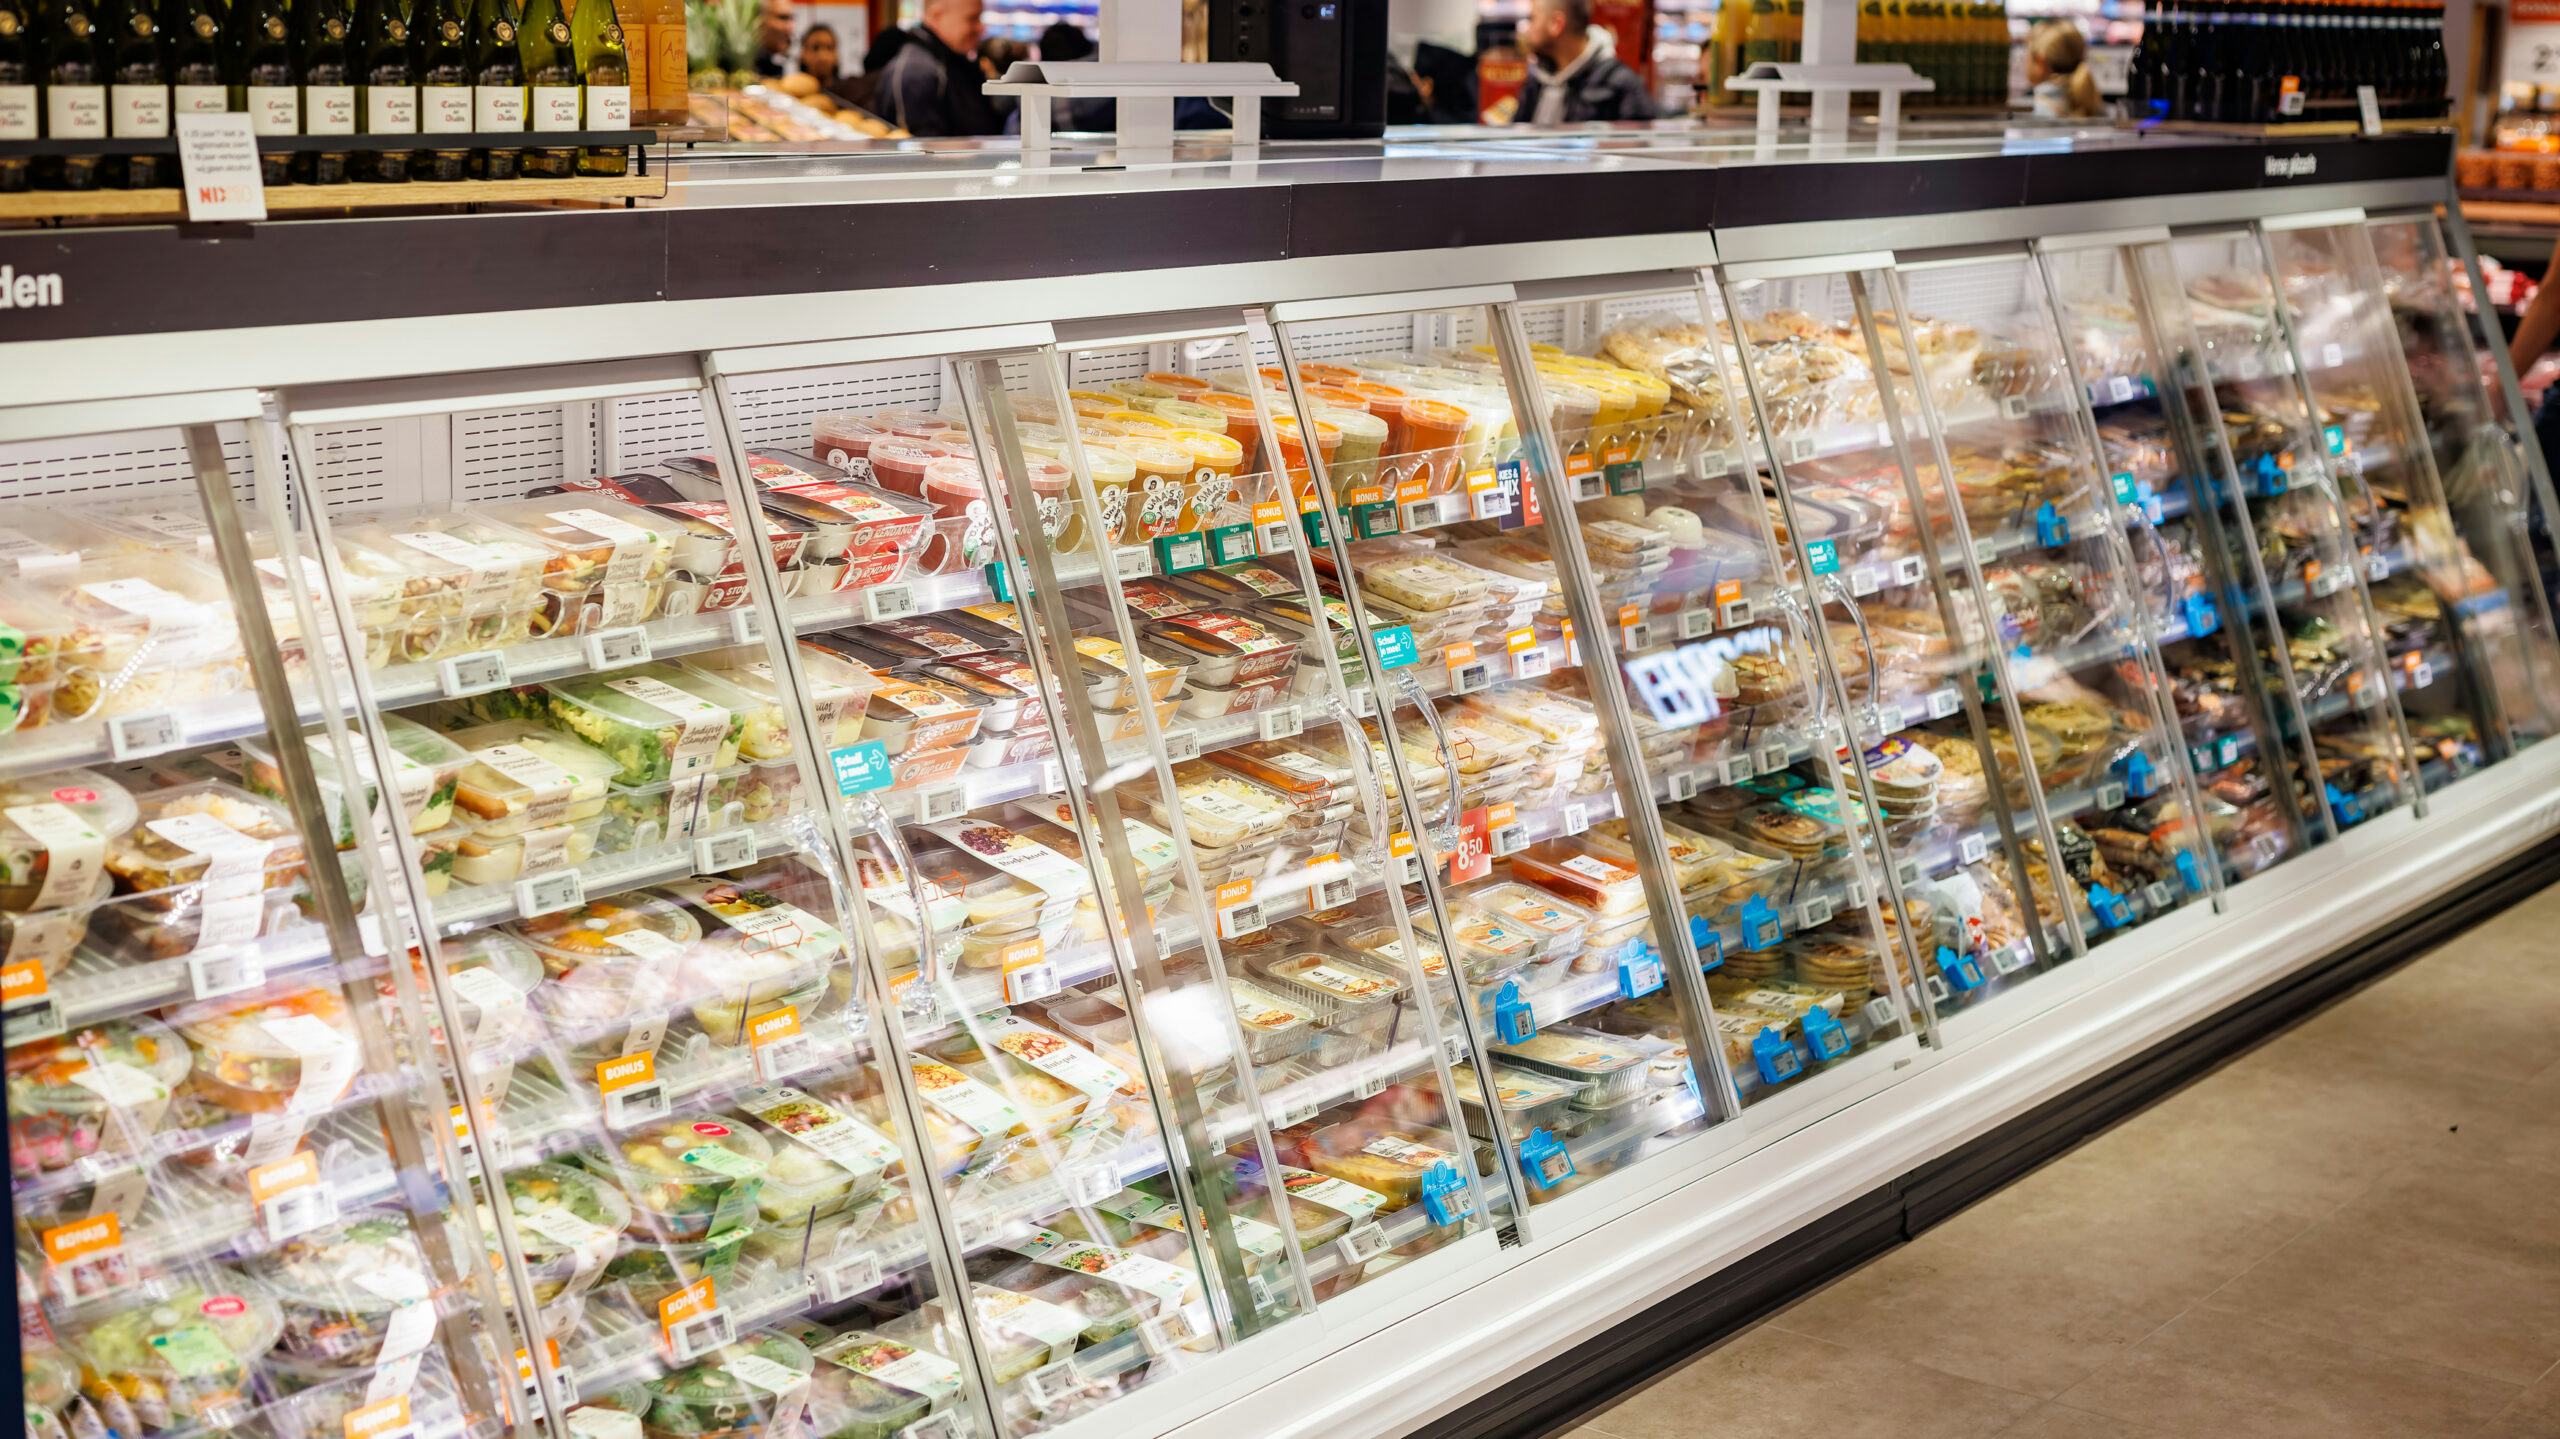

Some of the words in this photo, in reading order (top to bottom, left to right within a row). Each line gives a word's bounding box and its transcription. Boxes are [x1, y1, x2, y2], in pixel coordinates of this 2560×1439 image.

[1355, 492, 1379, 503] BONUS
[1402, 485, 1423, 497] BONUS
[1257, 505, 1281, 518] BONUS
[1221, 884, 1248, 900] BONUS
[1007, 945, 1040, 963] BONUS
[0, 969, 34, 989] NUS
[755, 1013, 793, 1037] BONUS
[605, 1060, 646, 1081] BONUS
[667, 1285, 708, 1317] BONUS
